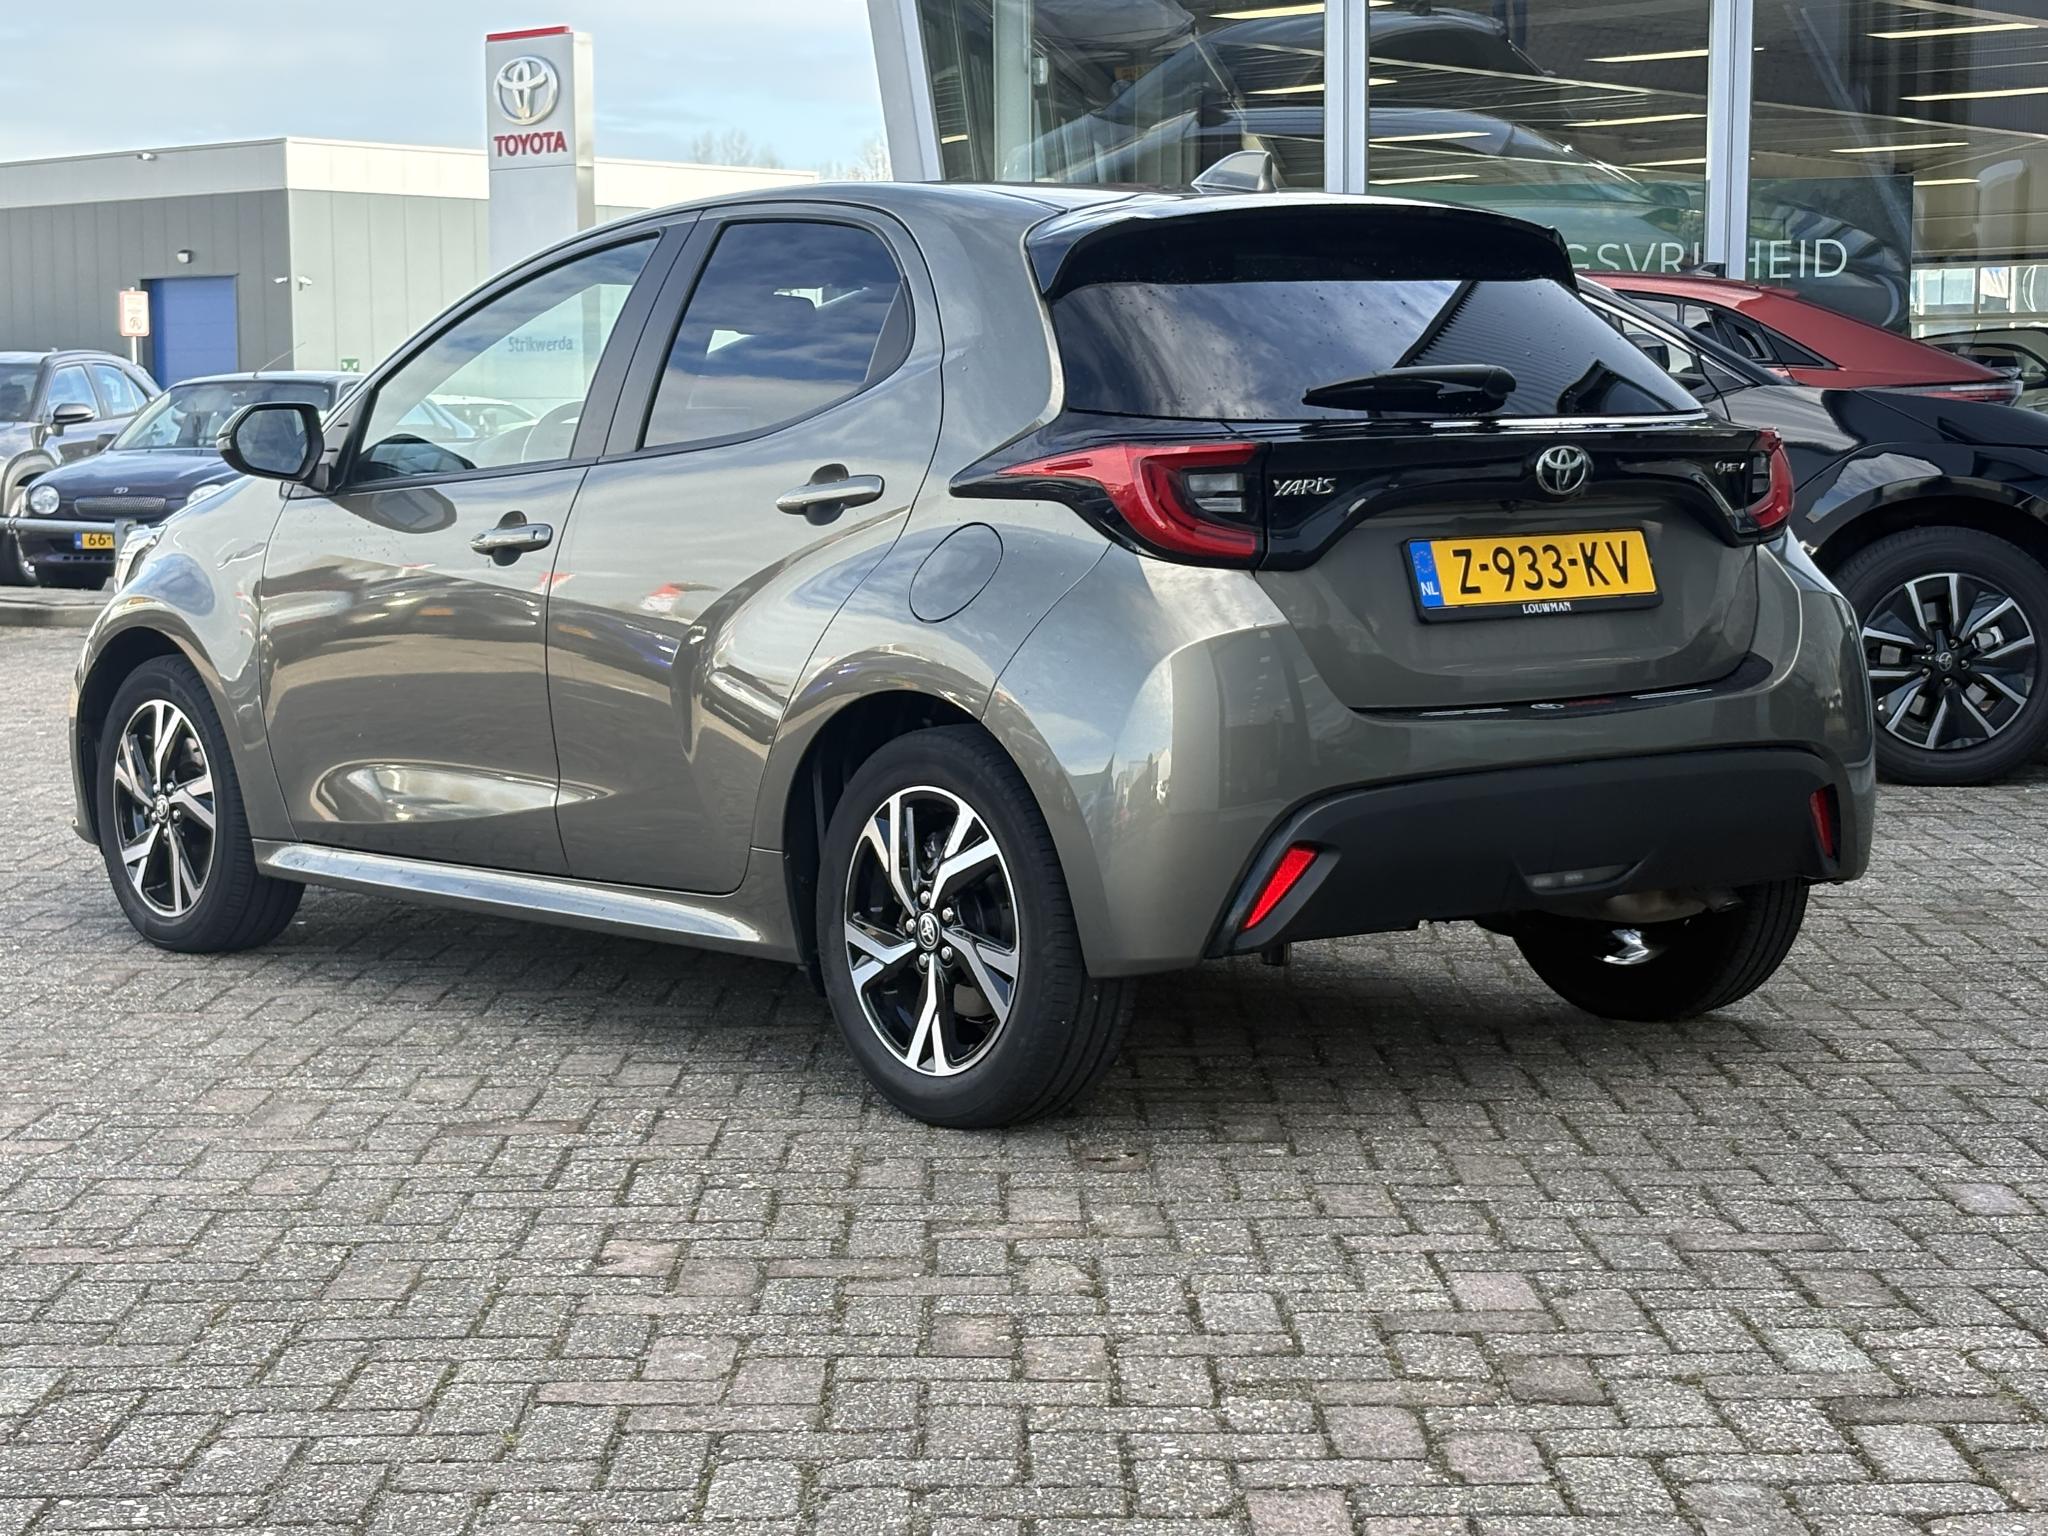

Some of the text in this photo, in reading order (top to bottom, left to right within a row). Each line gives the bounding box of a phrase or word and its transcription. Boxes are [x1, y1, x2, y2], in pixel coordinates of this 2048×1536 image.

[493, 130, 568, 158] TOYOTA
[508, 335, 573, 353] Strikwerda
[1452, 540, 1628, 595] Z-933-KV
[1421, 581, 1440, 596] NL
[1522, 601, 1572, 614] LOUWMAN
